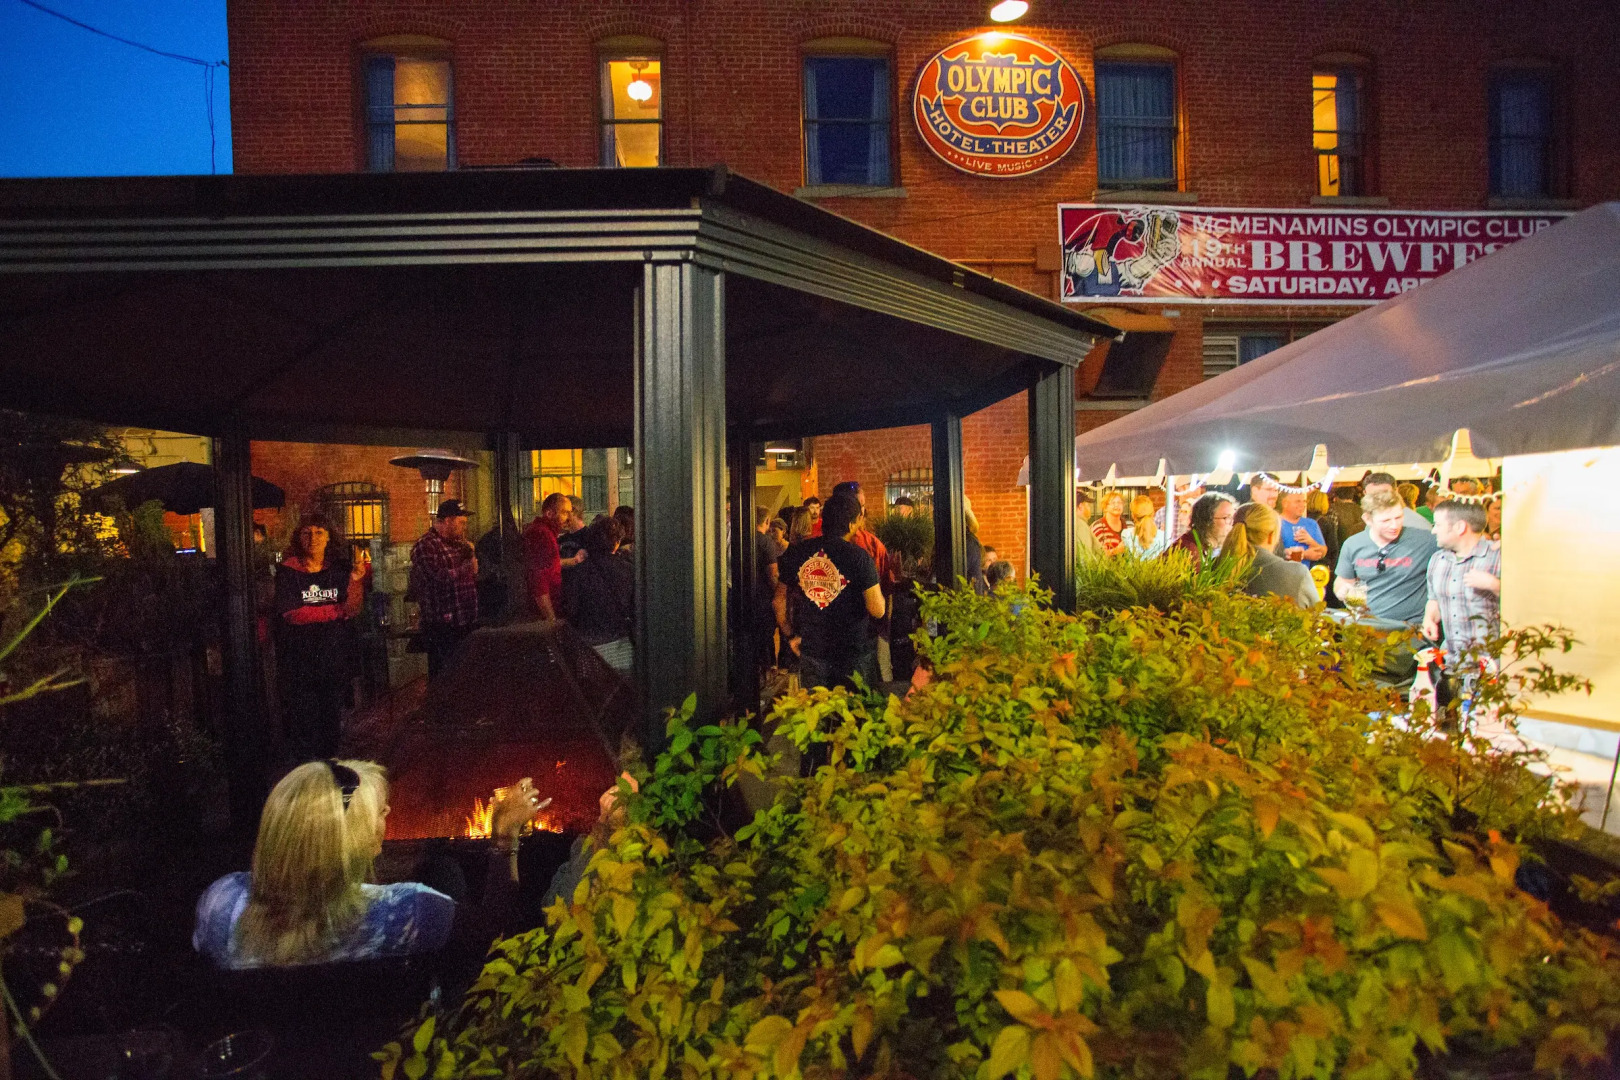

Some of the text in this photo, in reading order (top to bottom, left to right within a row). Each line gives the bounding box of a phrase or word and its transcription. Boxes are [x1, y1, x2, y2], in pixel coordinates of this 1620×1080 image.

[947, 65, 1052, 95] OLYMPIC
[970, 96, 1029, 119] CLUB
[929, 109, 1068, 154] HOTEL THEATER
[965, 157, 1032, 172] LIVE MUSIC
[1373, 217, 1481, 238] OLYMPIC
[1181, 256, 1246, 269] ANNUAL
[1247, 239, 1508, 272] BREWFE
[1228, 275, 1433, 296] SATURDAY, AP
